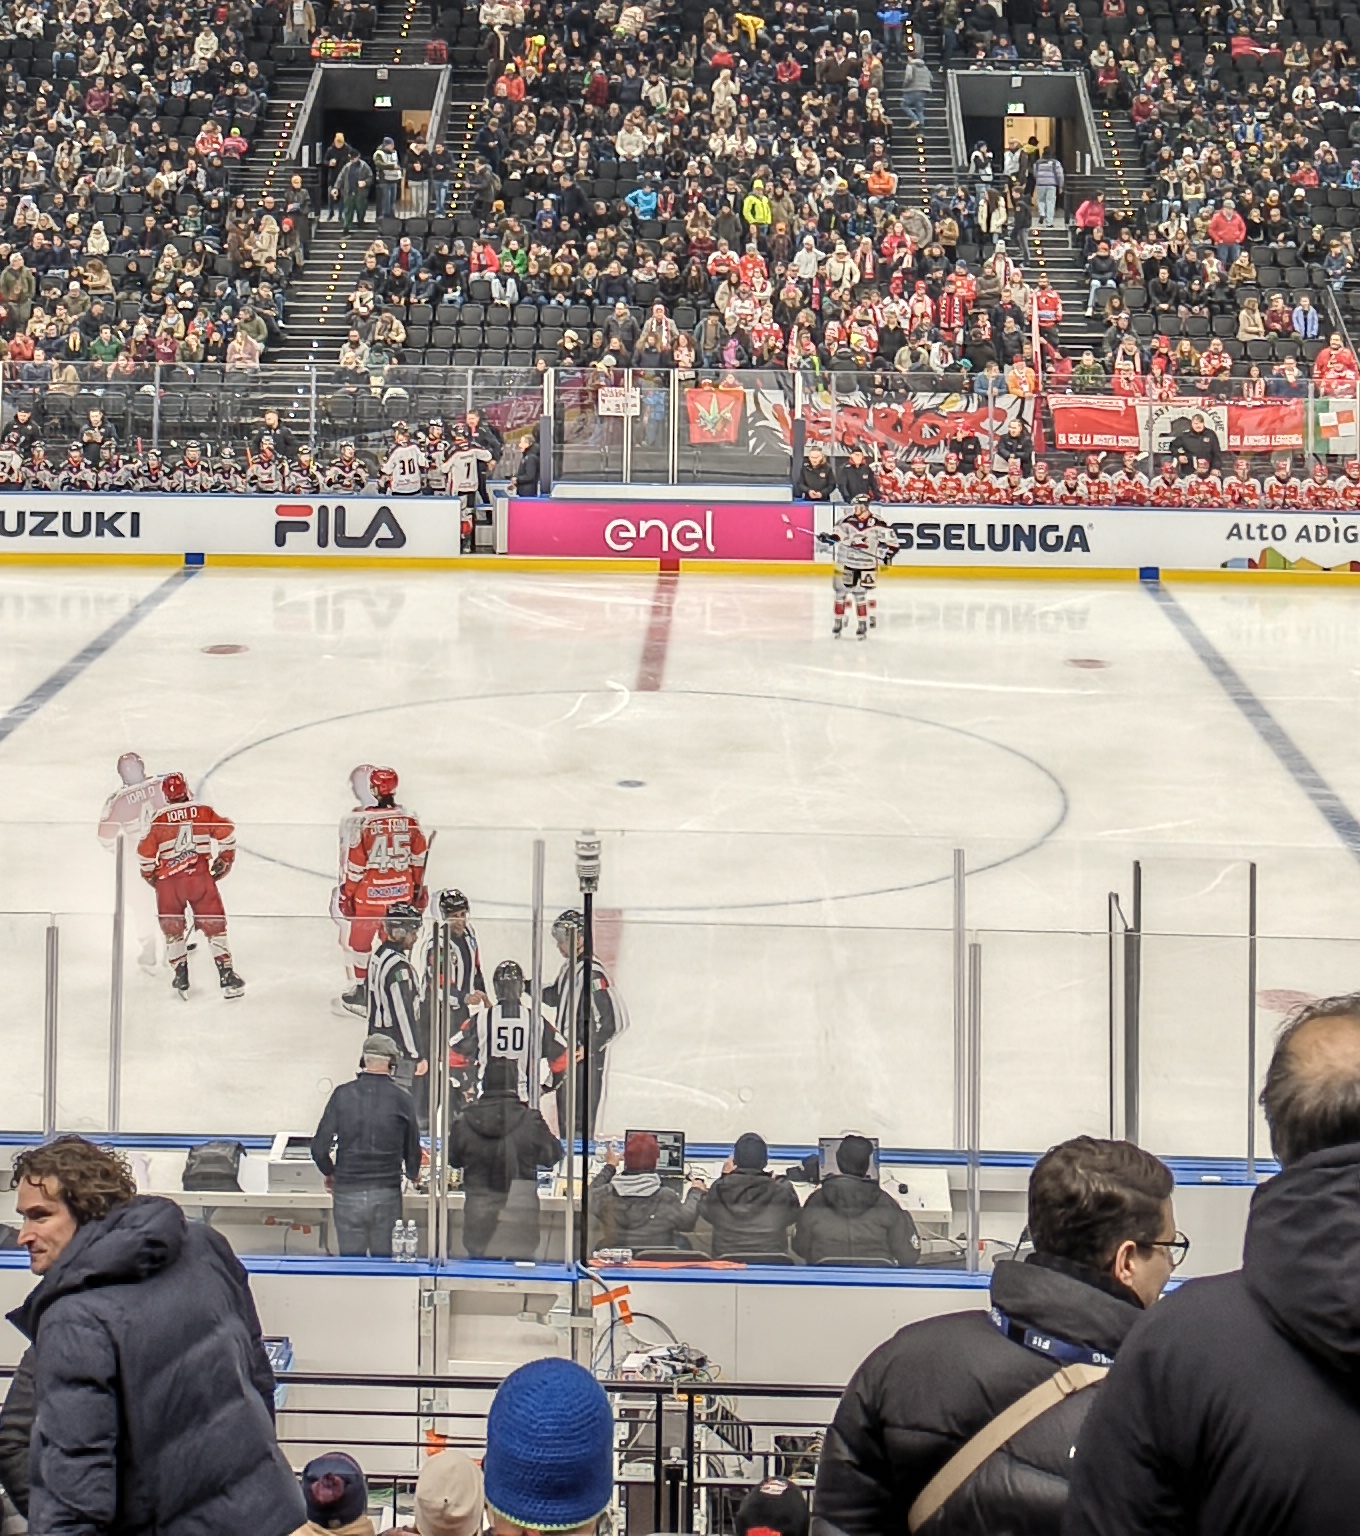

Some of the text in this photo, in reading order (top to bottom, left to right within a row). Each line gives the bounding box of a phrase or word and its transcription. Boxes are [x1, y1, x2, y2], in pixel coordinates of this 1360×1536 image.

[399, 458, 416, 476] 30
[274, 504, 407, 549] FILA
[604, 510, 715, 553] enel
[892, 521, 1091, 553] SSELUNGA
[174, 821, 196, 853] 4
[367, 833, 411, 873] 45
[496, 1027, 525, 1052] 50
